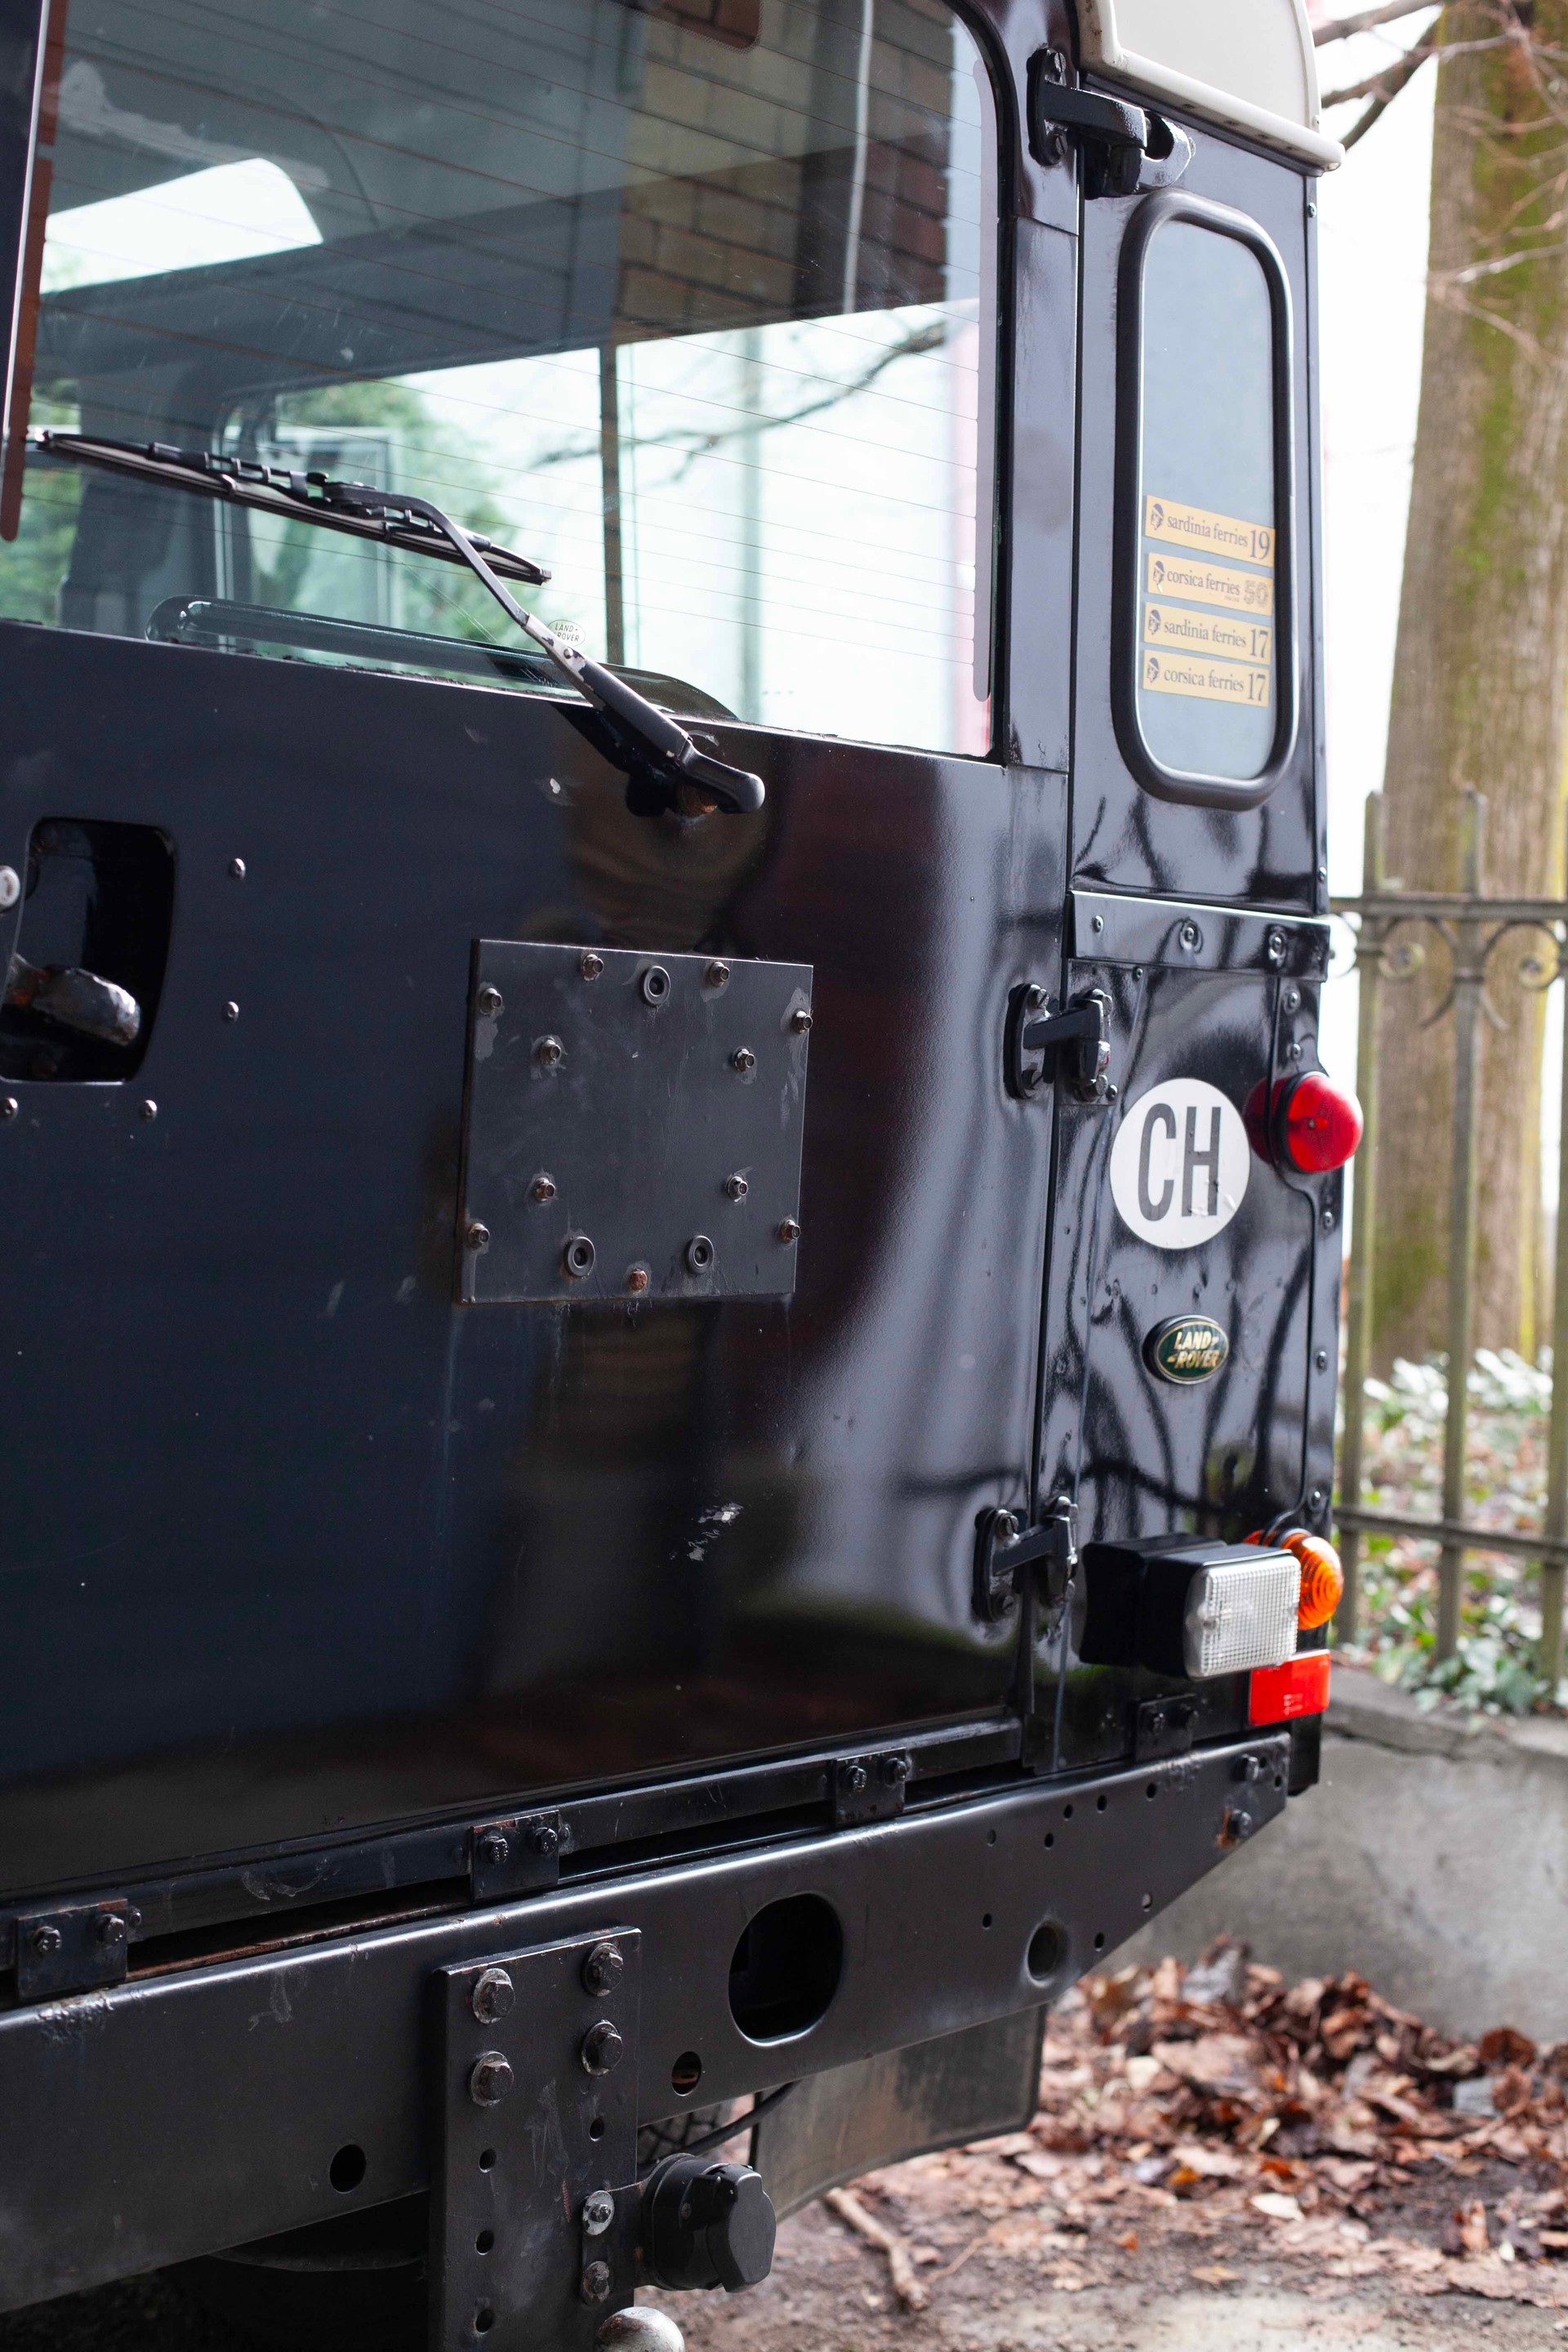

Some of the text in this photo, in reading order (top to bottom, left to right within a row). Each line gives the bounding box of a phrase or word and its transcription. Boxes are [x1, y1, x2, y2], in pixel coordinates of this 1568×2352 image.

[1167, 514, 1271, 560] sardinia ferries 19
[1167, 569, 1204, 589] corsica
[1206, 573, 1241, 596] ferries
[1164, 619, 1269, 659] sardinia ferries 17
[1164, 668, 1267, 702] corsica ferries 17
[1138, 1102, 1222, 1222] CH
